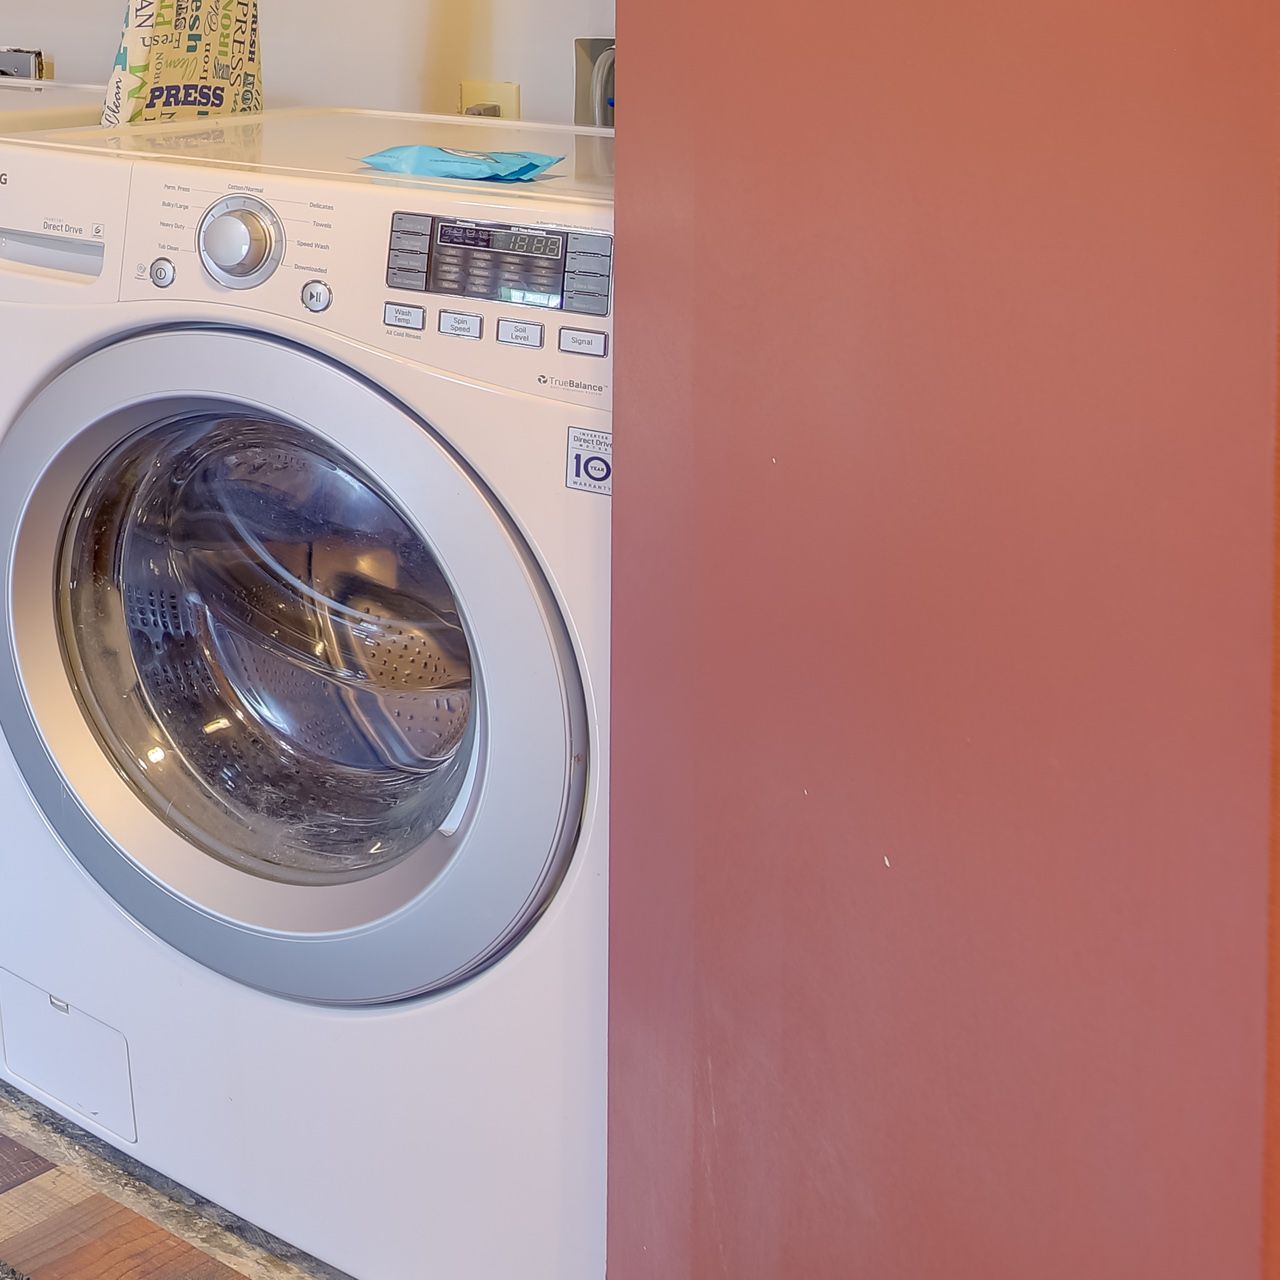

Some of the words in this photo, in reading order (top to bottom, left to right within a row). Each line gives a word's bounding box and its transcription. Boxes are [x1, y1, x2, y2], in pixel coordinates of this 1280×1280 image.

[140, 32, 182, 49] Fresh
[229, 0, 249, 87] PRESS
[199, 42, 211, 82] Iron
[145, 84, 225, 109] PRESS
[309, 201, 334, 211] Delicates
[43, 221, 64, 232] Direct
[64, 224, 83, 234] Drive
[312, 220, 332, 229] Towels
[297, 240, 313, 250] Speed
[314, 242, 330, 251] Wash
[294, 263, 328, 274] Downloaded
[394, 308, 412, 317] Wash
[453, 317, 468, 325] Spin
[450, 324, 470, 333] Speed
[510, 333, 529, 342] Level
[571, 336, 592, 346] Signal
[573, 435, 594, 446] Direct
[574, 453, 612, 482] 10
